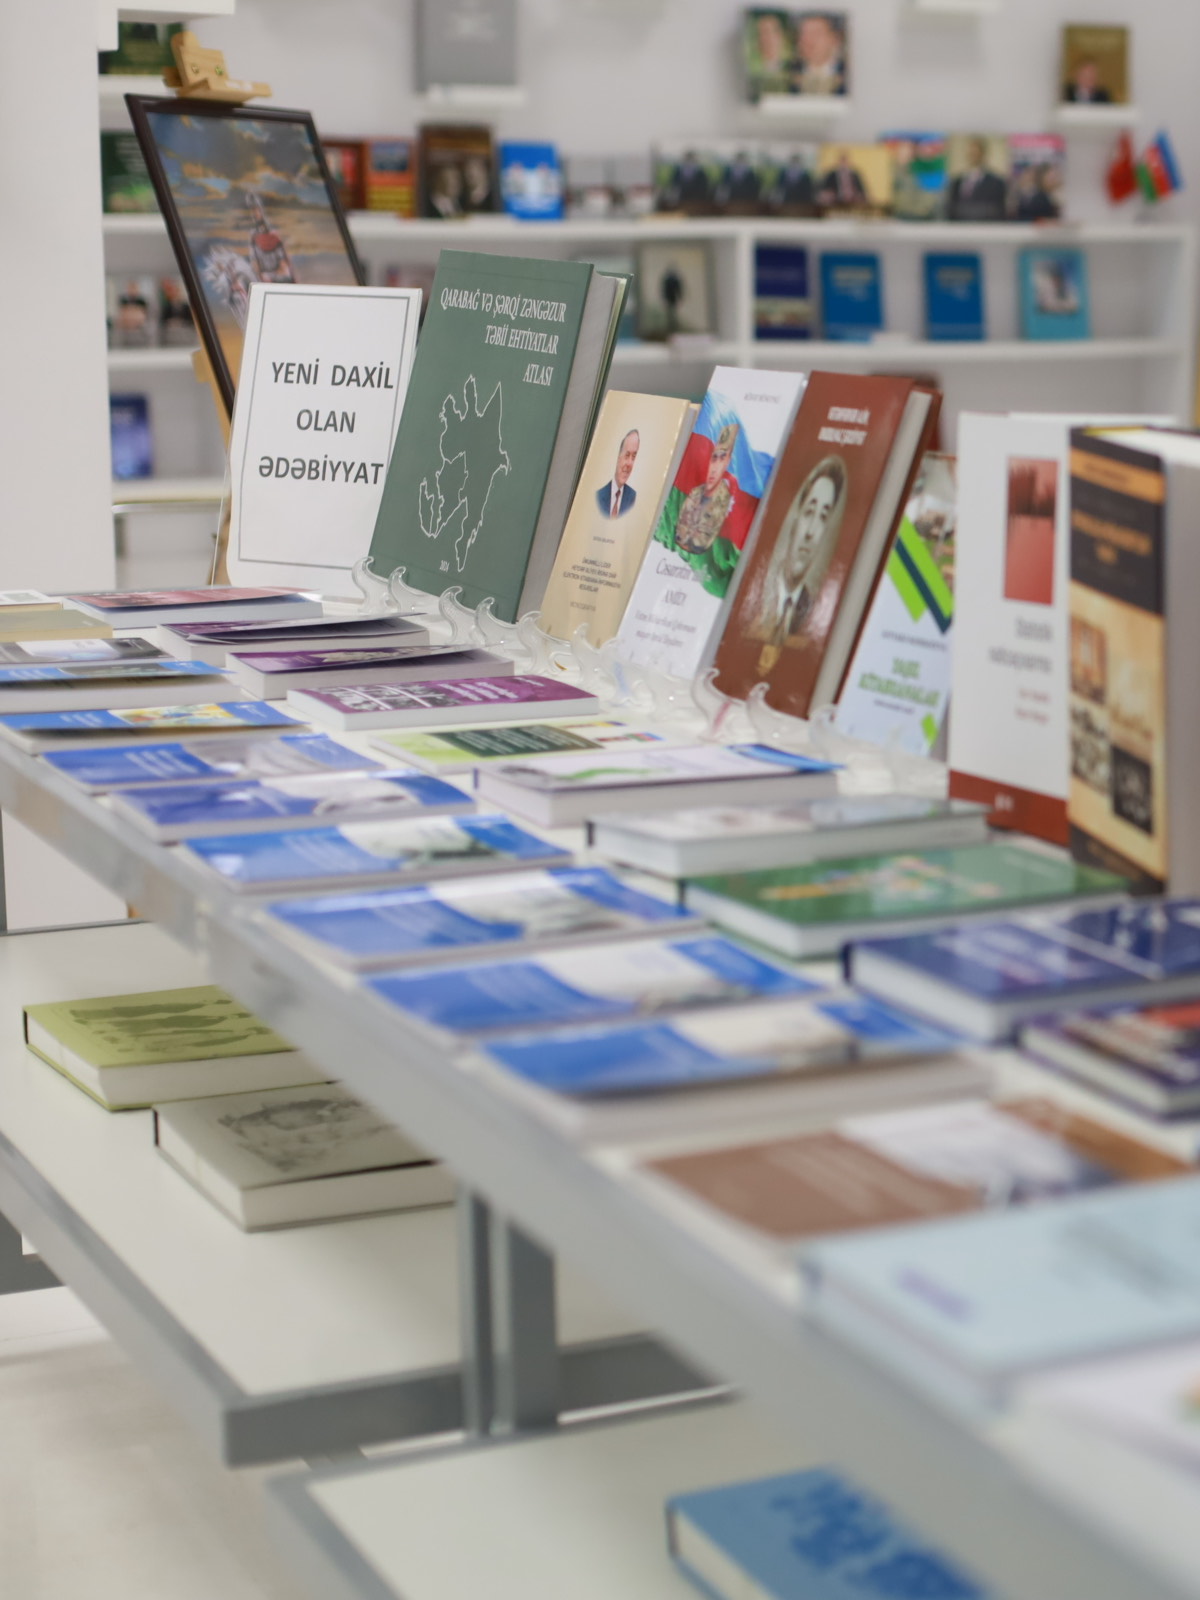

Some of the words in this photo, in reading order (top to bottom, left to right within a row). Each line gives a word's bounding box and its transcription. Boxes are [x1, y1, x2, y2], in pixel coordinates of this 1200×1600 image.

[441, 287, 480, 311] QARABAĞ
[481, 293, 494, 313] VƏ
[493, 294, 521, 320] ŞƏRQİ
[520, 298, 567, 323] ZƏNGƏZUR
[484, 324, 509, 347] TƏBİİ
[508, 328, 560, 355] EHTİYATLAR
[271, 358, 320, 386] YENİ
[330, 361, 394, 390] DAXİL
[522, 363, 554, 386] ATLASI
[296, 408, 356, 434] OLAN
[258, 454, 384, 485] ƏDƏBİYYAT
